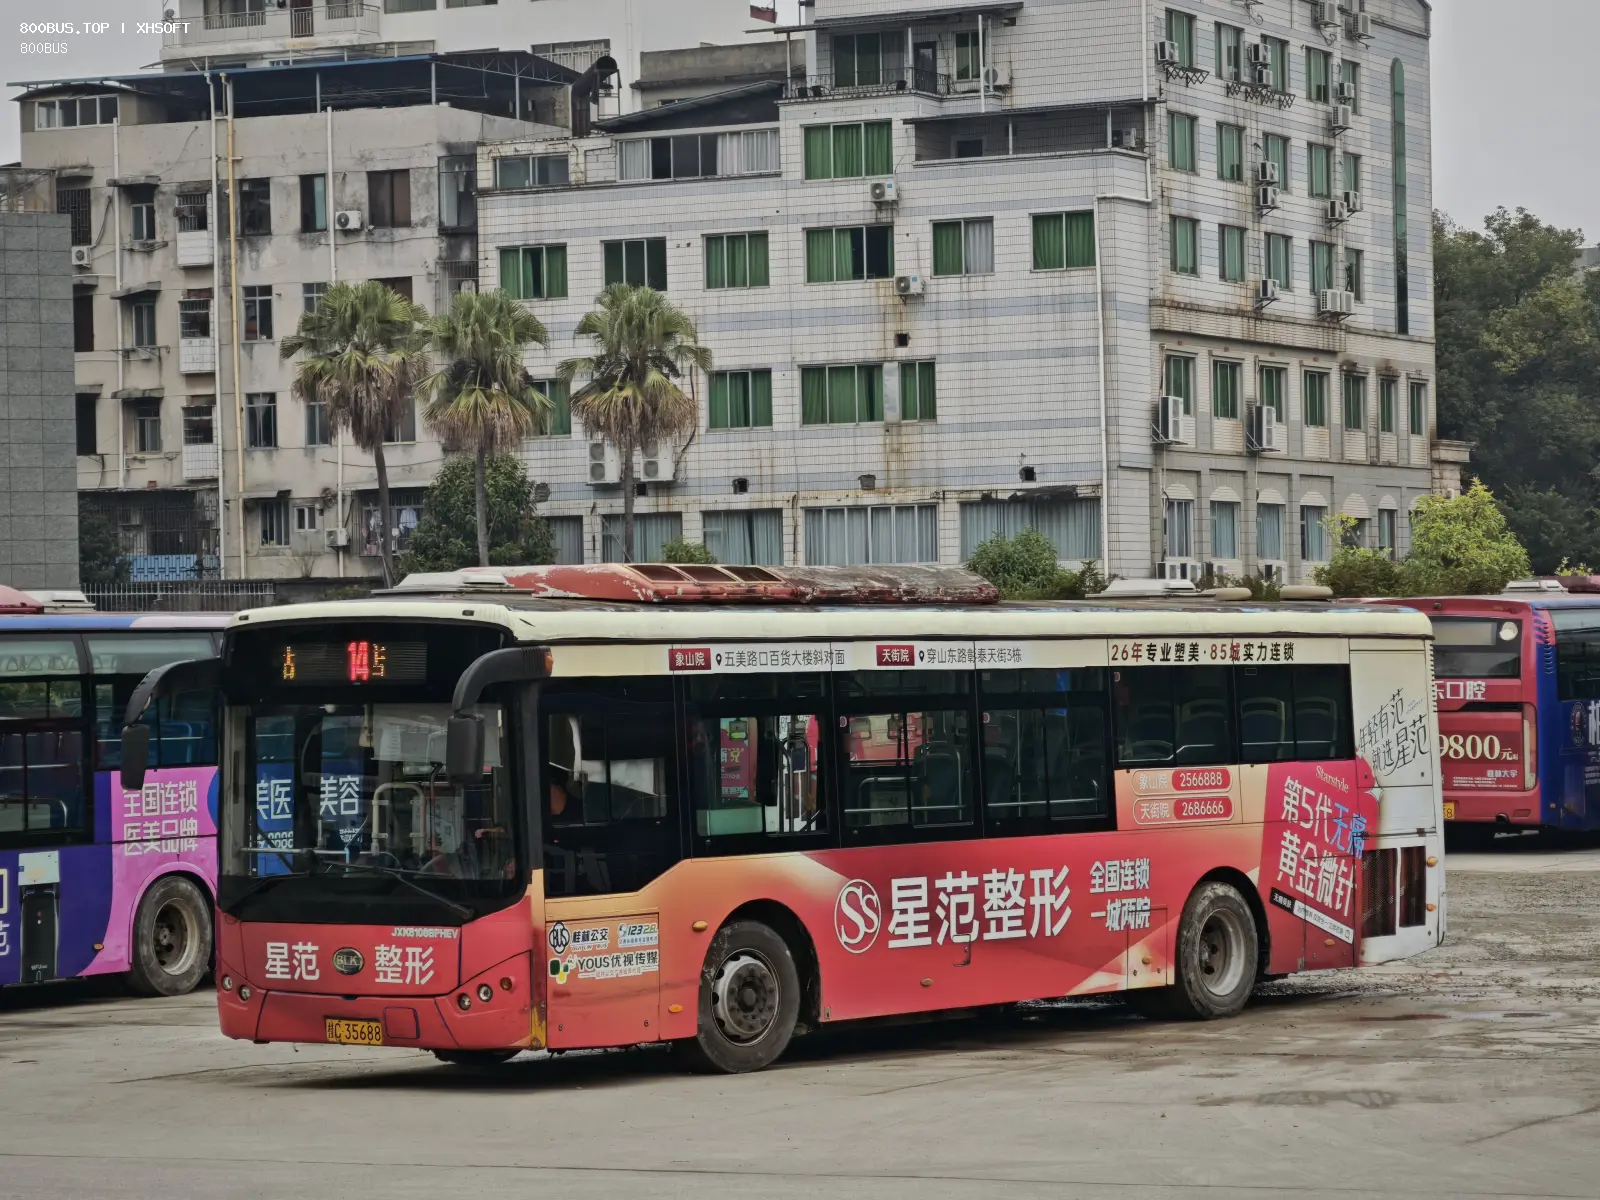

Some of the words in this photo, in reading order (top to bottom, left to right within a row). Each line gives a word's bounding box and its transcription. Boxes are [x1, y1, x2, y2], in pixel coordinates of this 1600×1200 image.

[674, 651, 706, 667] 象山院
[724, 649, 846, 667] 五美路口百货大楼斜对面
[881, 648, 910, 663] 天街院
[926, 647, 1023, 664] 穿山东路彰泰天街3栋
[319, 775, 360, 816] 美容
[1139, 773, 1168, 789] 象山院
[1179, 771, 1223, 787] 2566888
[1315, 765, 1349, 793] Starstyle
[123, 780, 198, 818] 全国连锁
[1140, 802, 1170, 819] 天街院
[1181, 800, 1225, 816] 2686666
[123, 817, 199, 857] 医美品牌
[1089, 857, 1151, 894] 全国连锁
[1276, 830, 1358, 917] 黄金微针
[887, 864, 1073, 949] 星范整形
[1090, 897, 1151, 932] 一城两院
[264, 942, 320, 981] 星范
[374, 943, 435, 985] 整形
